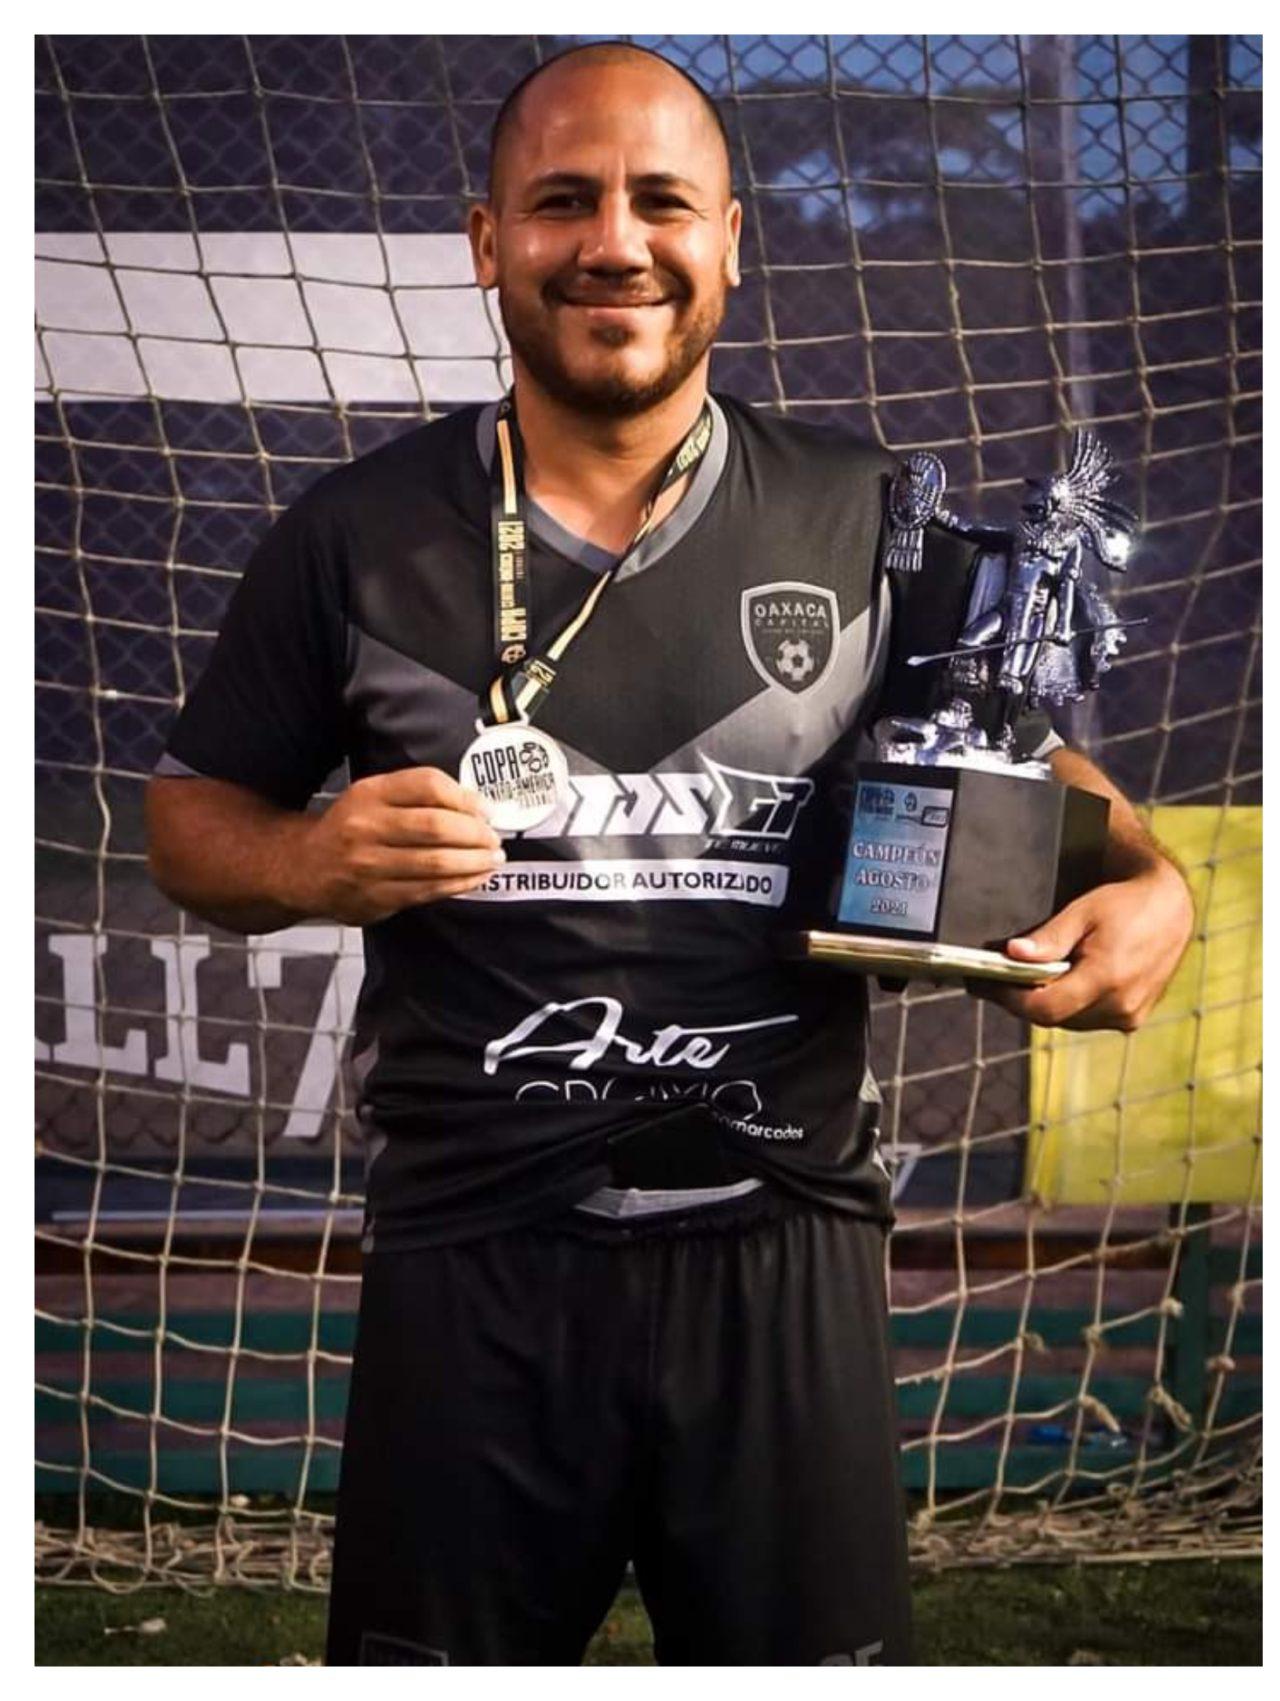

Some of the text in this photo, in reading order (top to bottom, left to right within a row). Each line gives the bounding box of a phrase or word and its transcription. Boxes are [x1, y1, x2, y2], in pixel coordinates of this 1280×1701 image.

[754, 602, 828, 619] OAXACA
[471, 746, 521, 787] COPA
[476, 871, 627, 893] ISTRIBUIDOR
[855, 867, 930, 892] AGOSTO
[35, 934, 251, 1097] LL
[483, 996, 799, 1077] Arte
